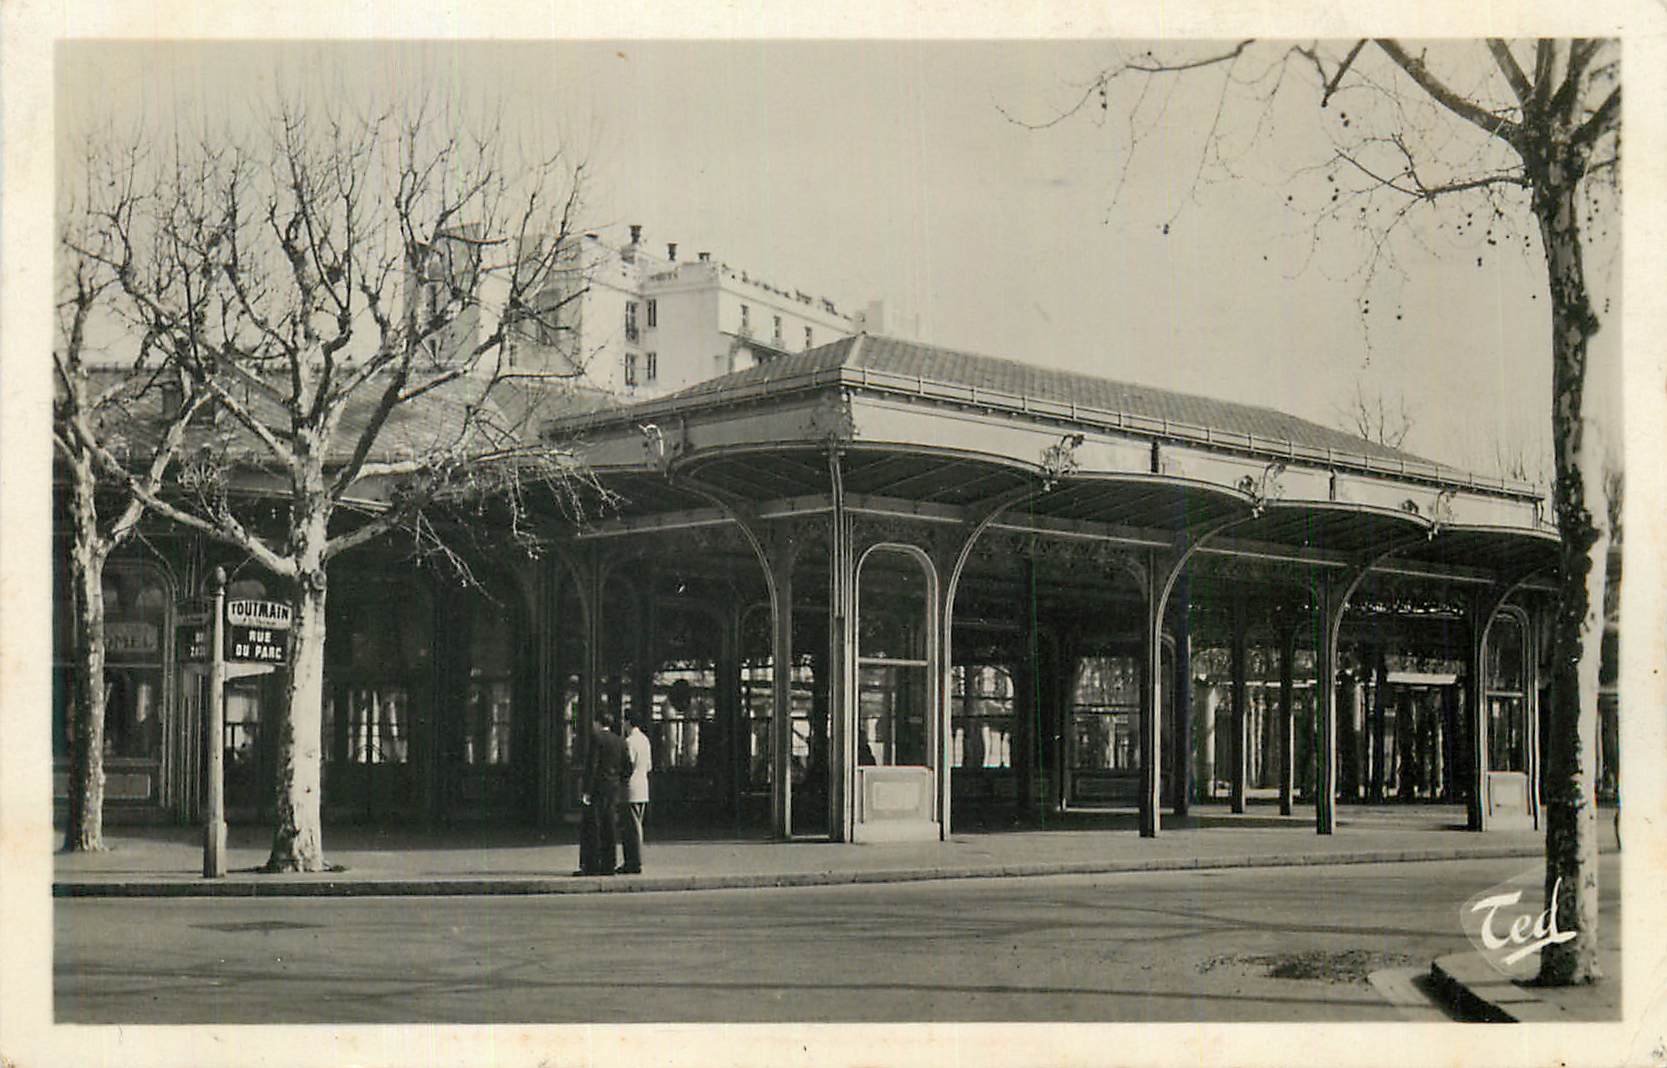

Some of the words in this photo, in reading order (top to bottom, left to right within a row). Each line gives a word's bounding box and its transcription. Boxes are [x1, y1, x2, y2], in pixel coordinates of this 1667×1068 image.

[249, 629, 271, 643] RUE
[235, 644, 250, 657] DU
[255, 645, 283, 659] PARC
